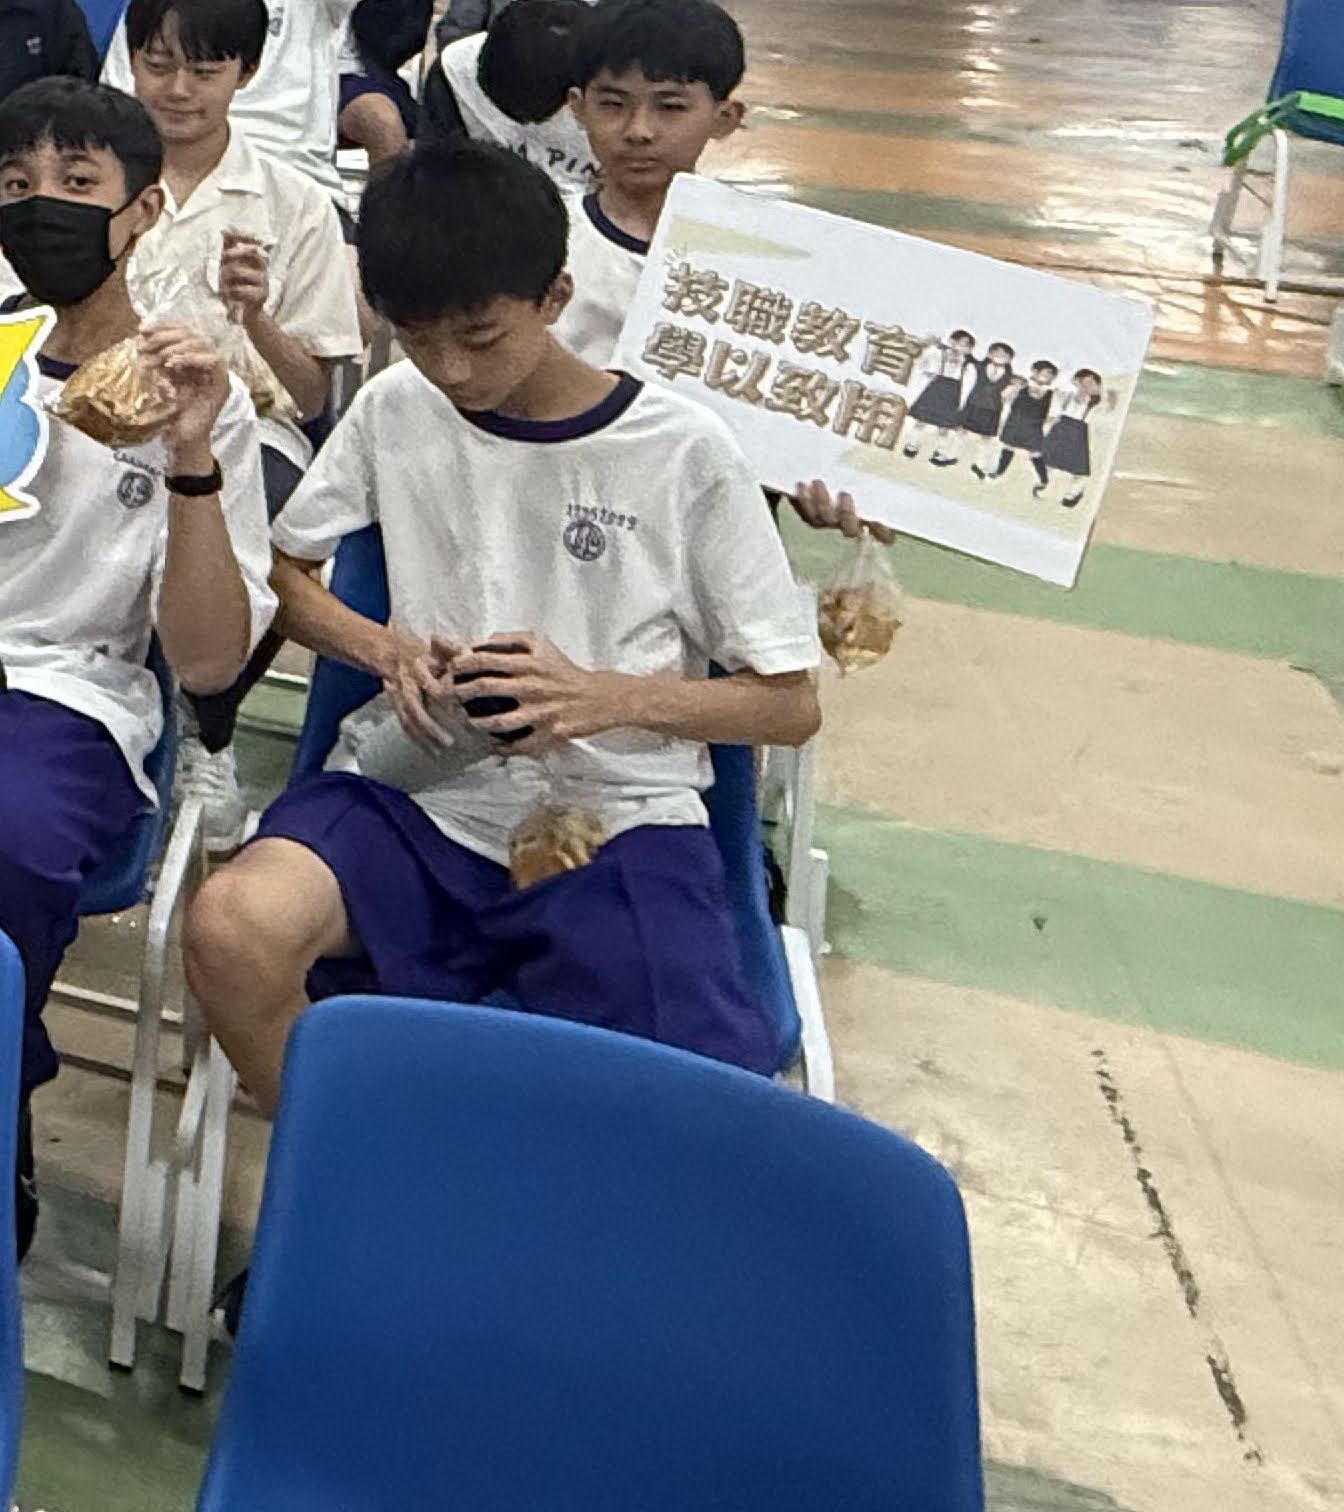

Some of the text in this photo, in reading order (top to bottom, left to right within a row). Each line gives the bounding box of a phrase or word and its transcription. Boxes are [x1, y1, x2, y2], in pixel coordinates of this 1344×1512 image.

[641, 321, 909, 451] 學以致用
[662, 262, 924, 390] 技職教育
